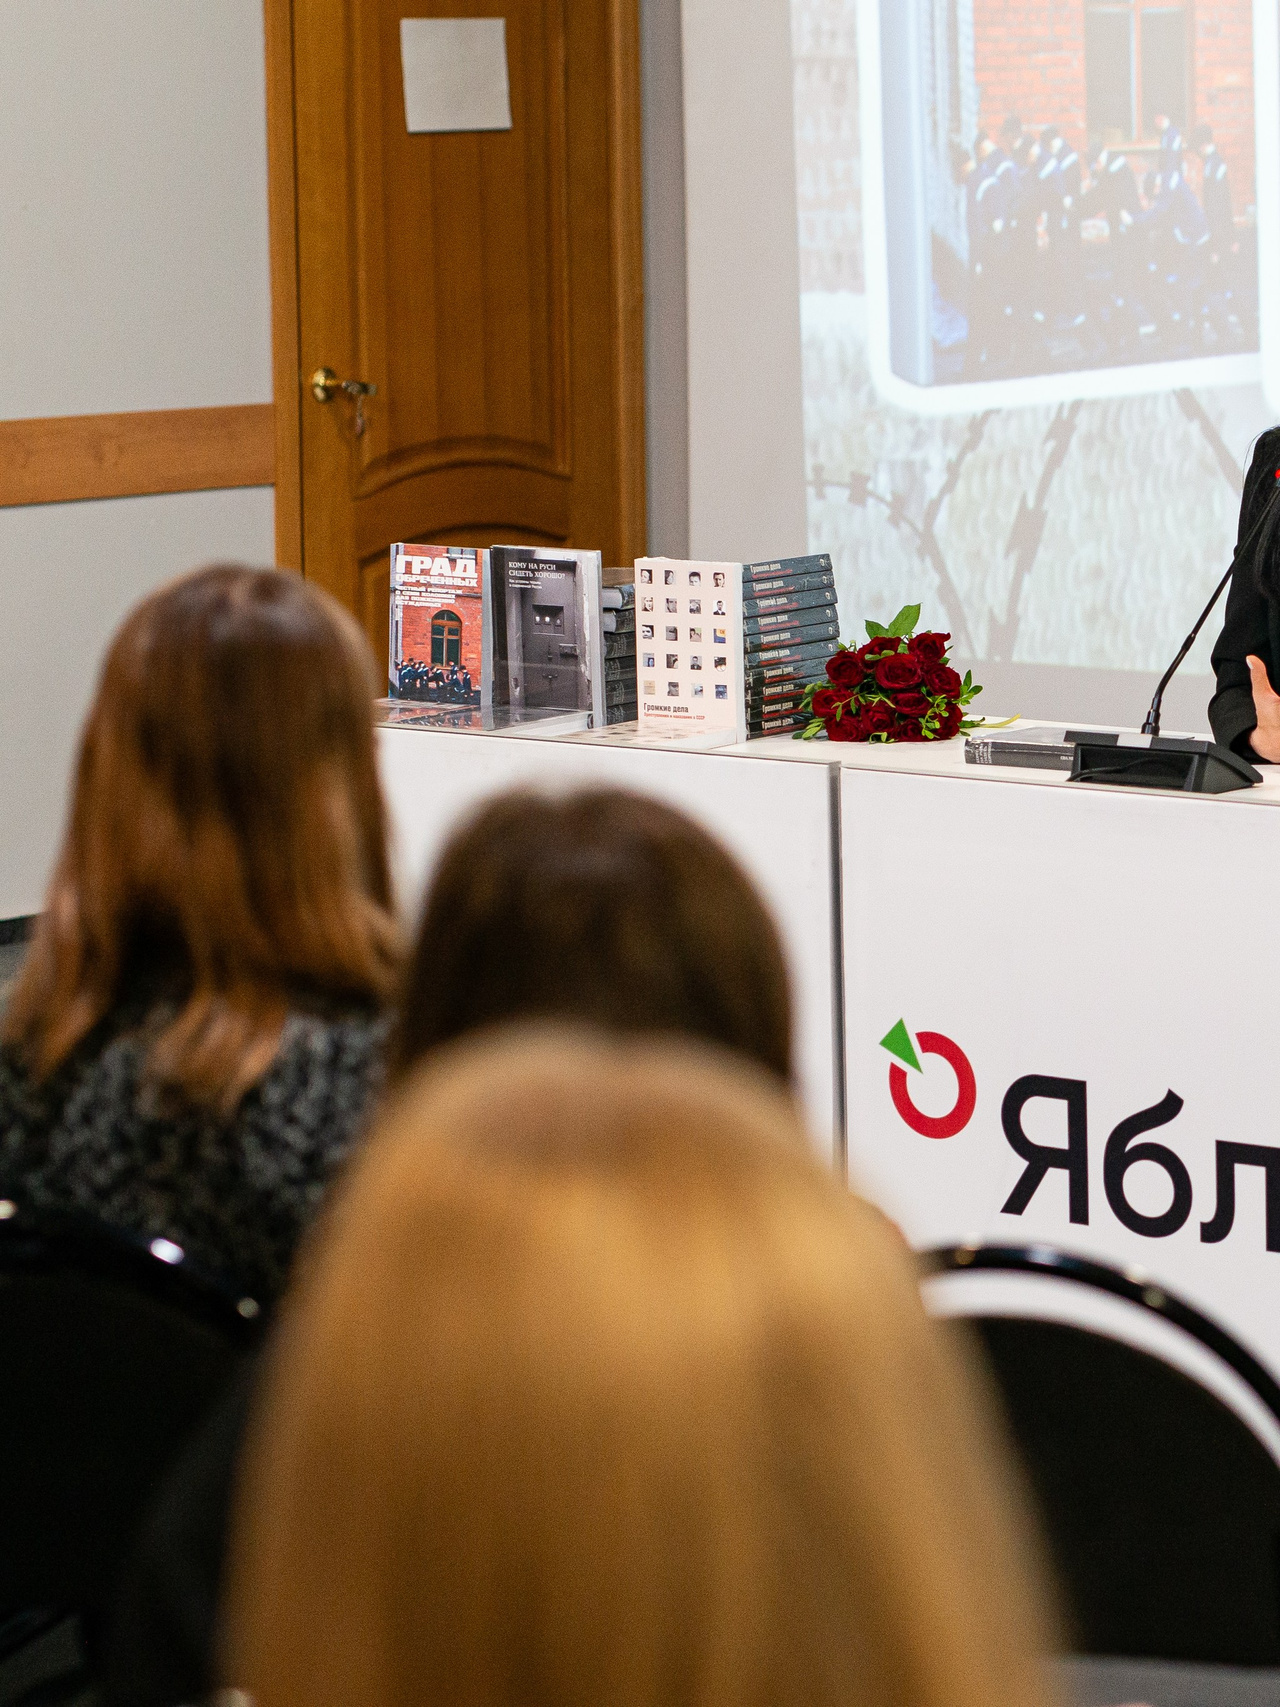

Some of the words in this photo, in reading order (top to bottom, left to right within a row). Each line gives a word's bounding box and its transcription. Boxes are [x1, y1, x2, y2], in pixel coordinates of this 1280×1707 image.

[396, 554, 478, 578] ГРАД
[535, 571, 566, 579] ХОРОШО?
[644, 703, 671, 712] Громкие
